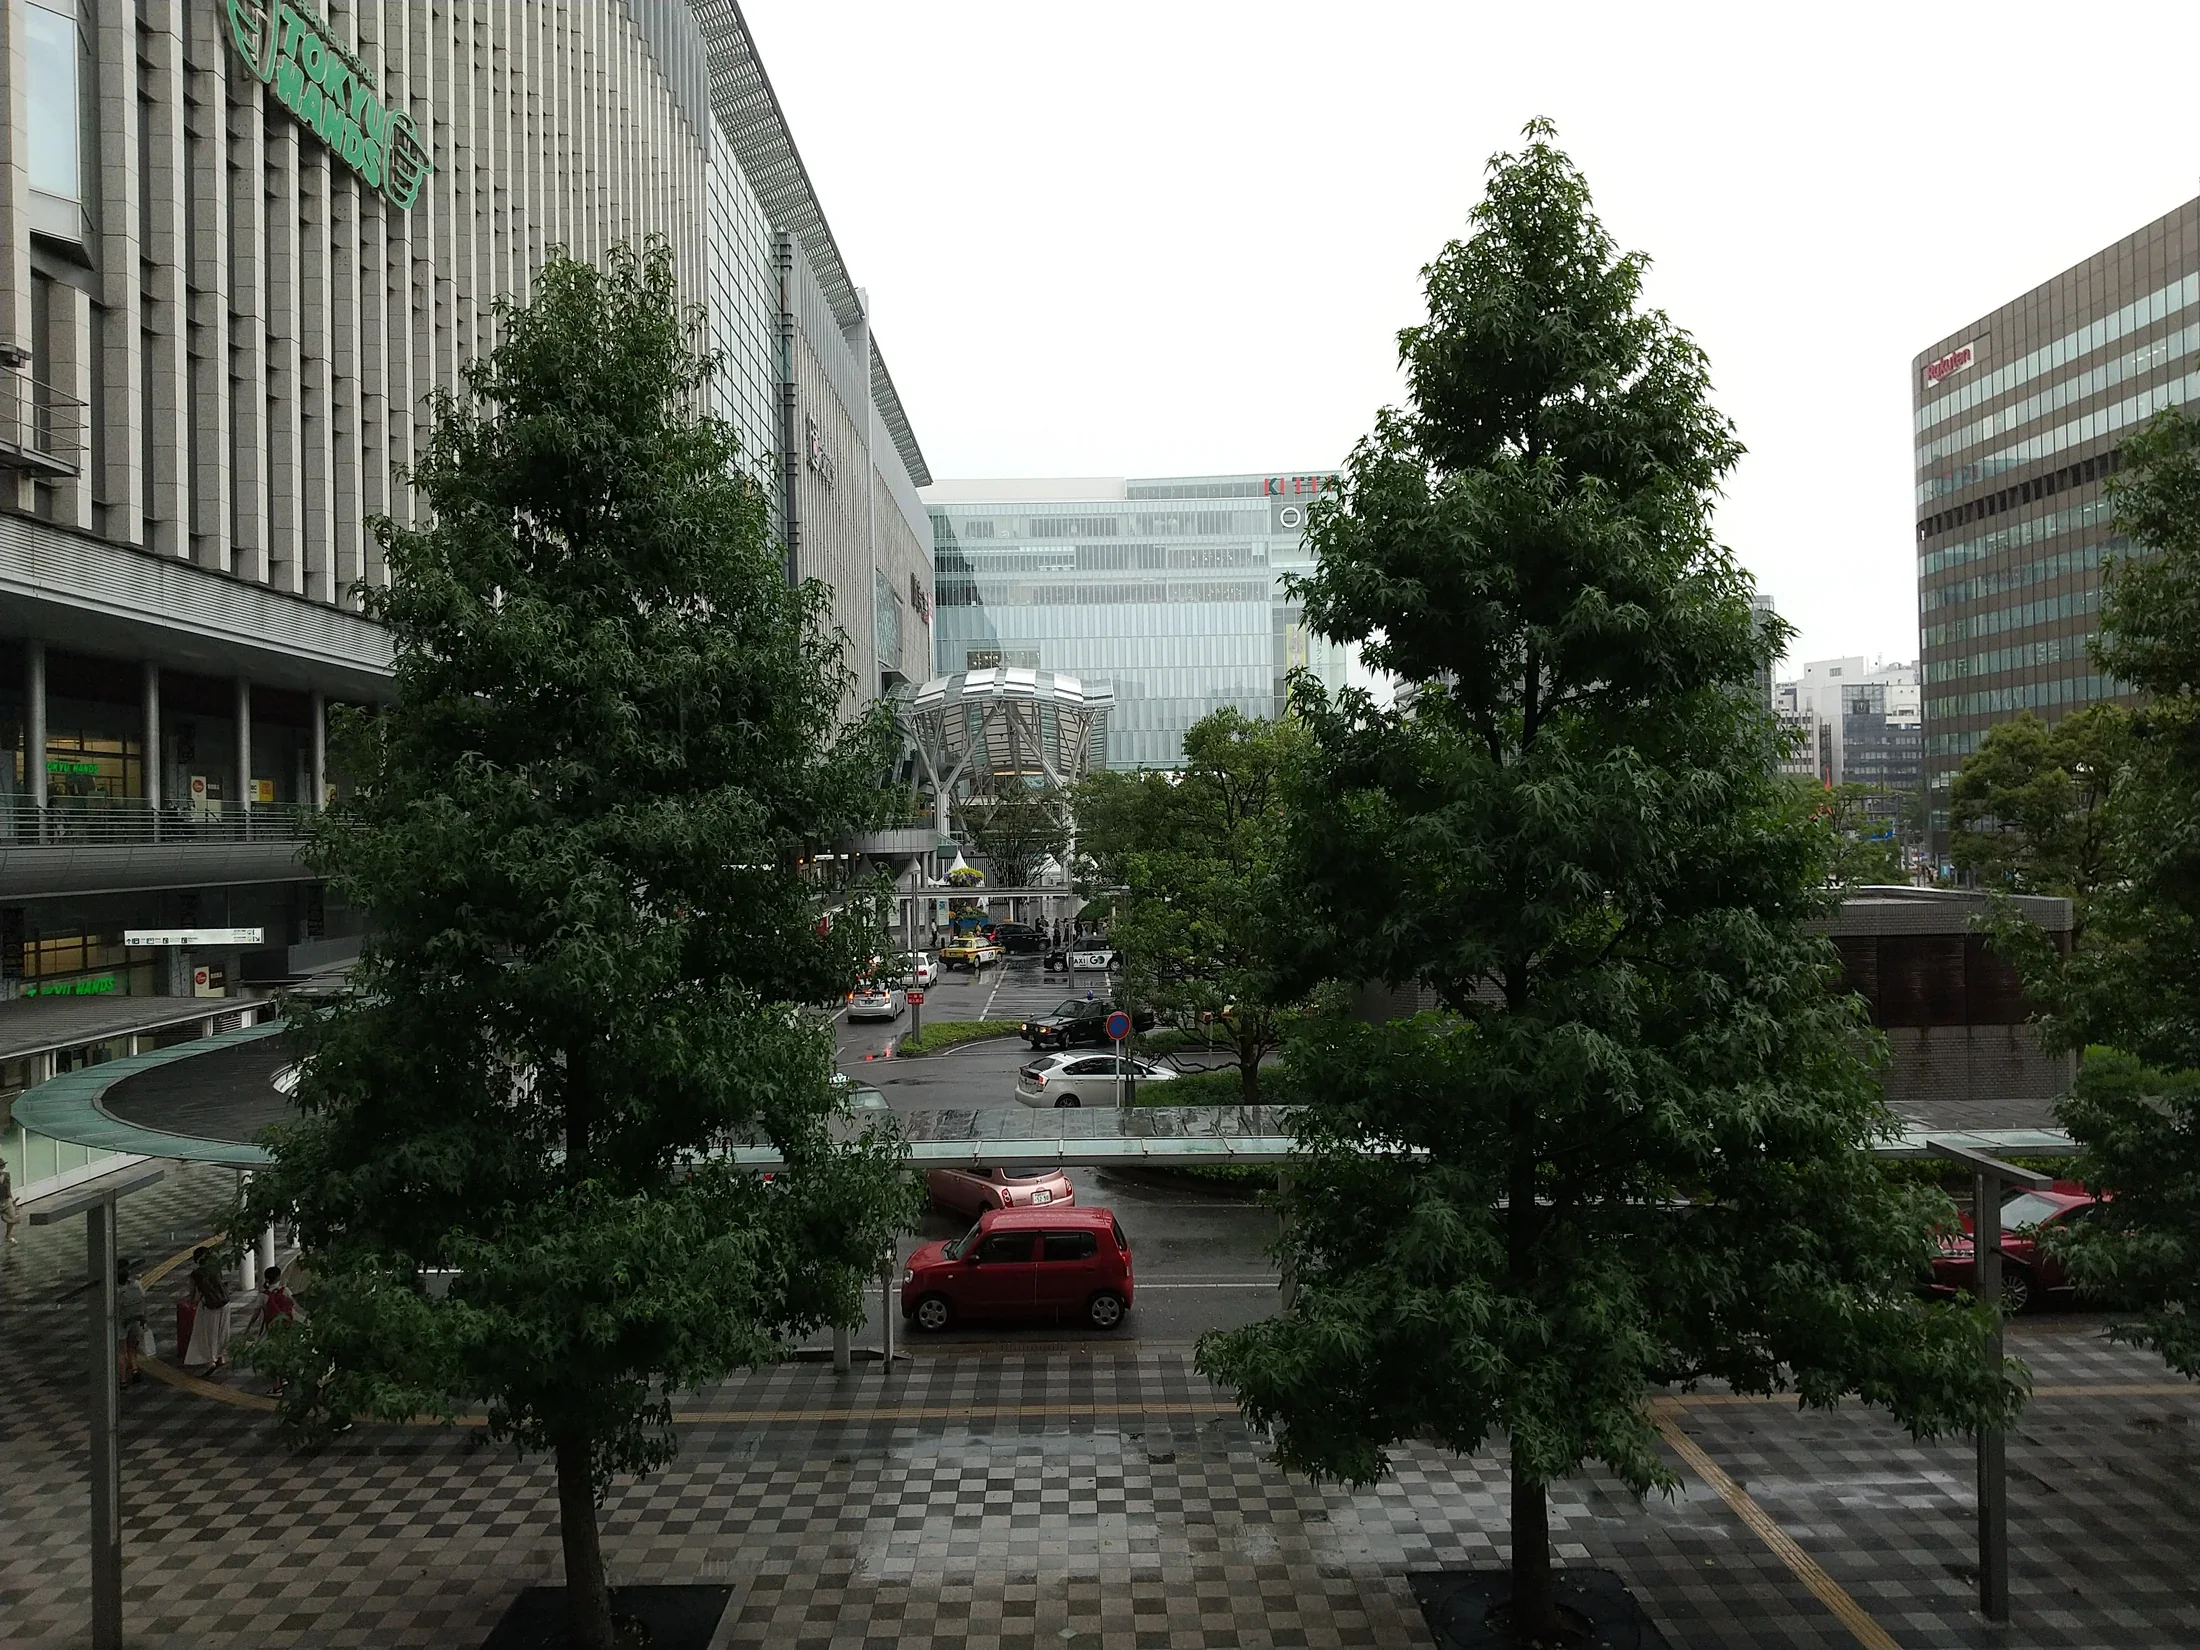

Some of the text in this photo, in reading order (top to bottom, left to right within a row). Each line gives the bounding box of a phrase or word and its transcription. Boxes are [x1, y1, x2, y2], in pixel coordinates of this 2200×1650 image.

[281, 3, 387, 147] TOKYU
[277, 55, 381, 188] HANDS
[1927, 348, 1971, 381] Rakuten
[45, 761, 70, 773] OKYU
[1089, 955, 1106, 965] GO
